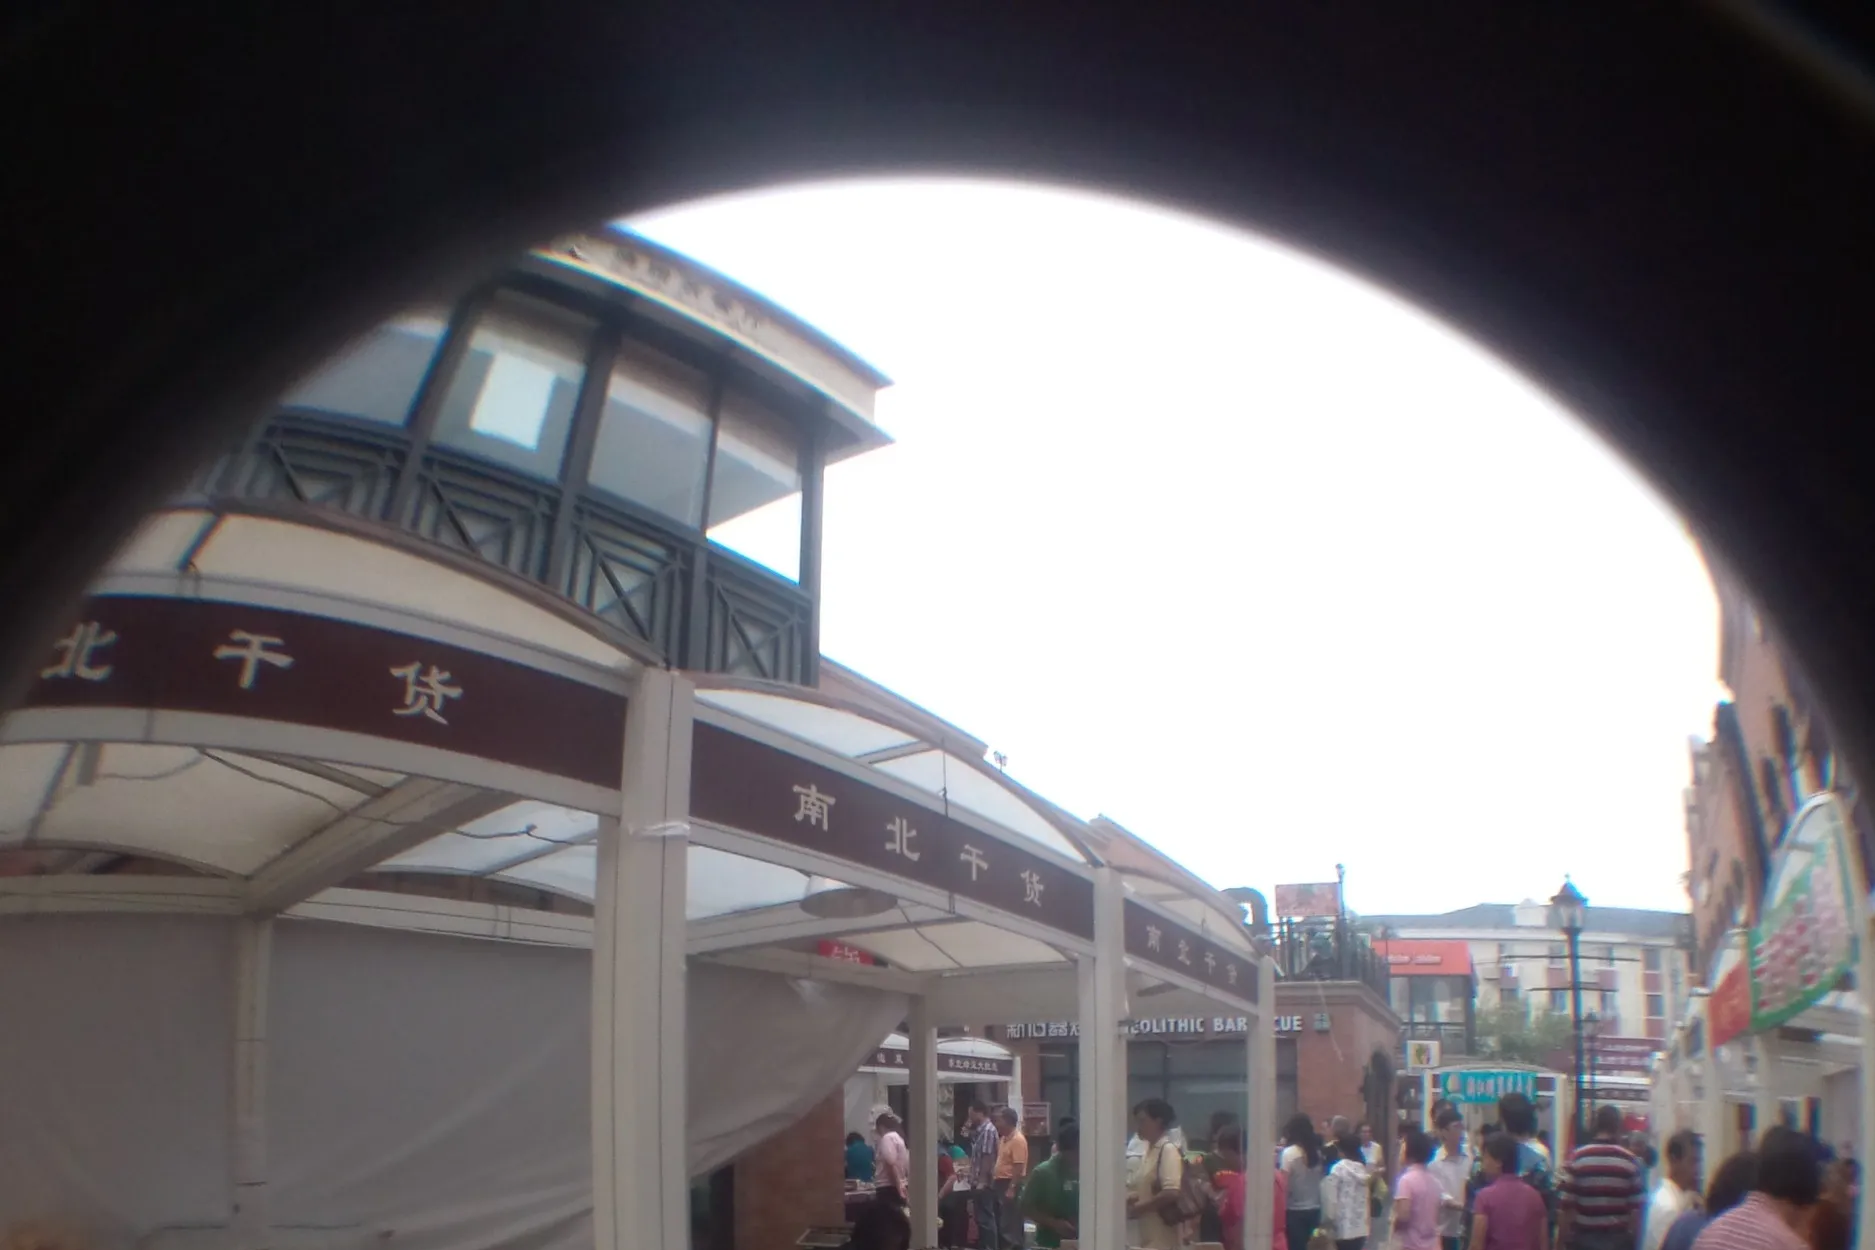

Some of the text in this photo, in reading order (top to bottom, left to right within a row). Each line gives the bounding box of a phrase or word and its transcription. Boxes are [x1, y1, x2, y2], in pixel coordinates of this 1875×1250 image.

[41, 620, 464, 726] 北干货
[792, 783, 1045, 907] 南北干货
